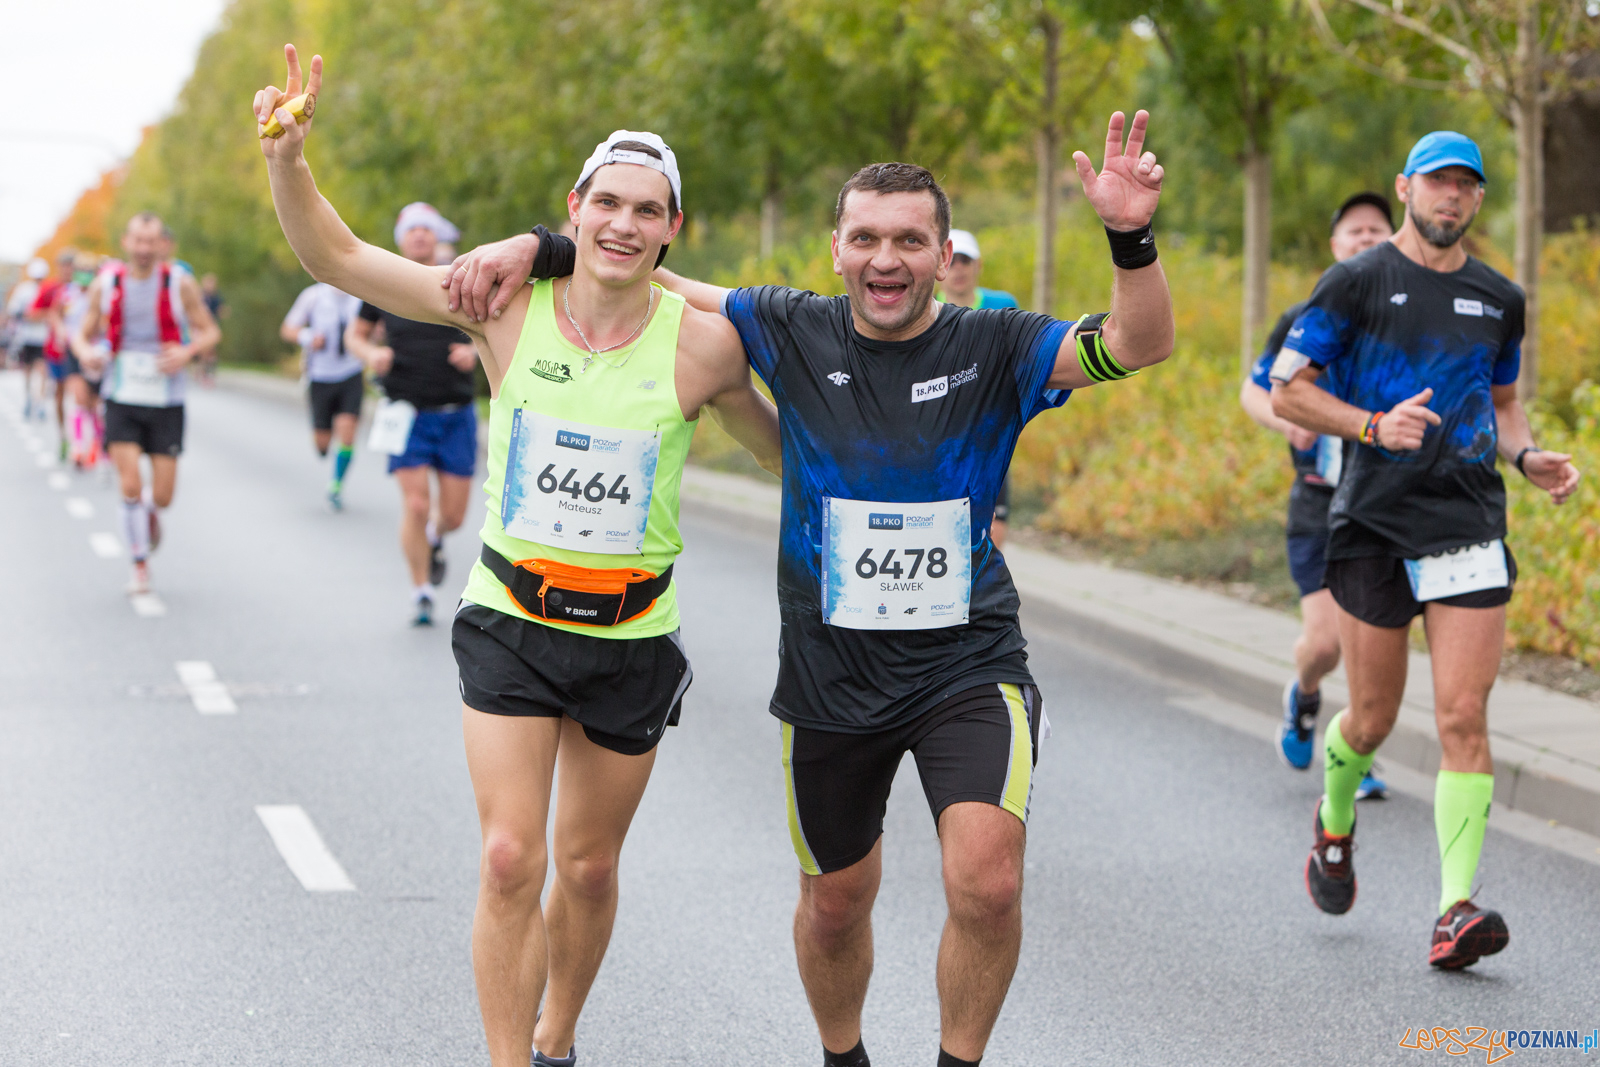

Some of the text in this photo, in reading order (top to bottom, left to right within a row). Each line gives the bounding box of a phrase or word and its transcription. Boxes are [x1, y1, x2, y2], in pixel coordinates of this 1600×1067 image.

[827, 371, 851, 387] 4F
[950, 372, 978, 389] maraton
[592, 444, 619, 453] maraton
[537, 463, 631, 505] 6464
[558, 500, 602, 515] Mateusz
[906, 520, 933, 528] maraton
[579, 529, 594, 538] 4F
[855, 547, 948, 580] 6478
[880, 582, 924, 592] SŁAWEK
[573, 608, 598, 617] BRUGI
[903, 607, 919, 615] 4F
